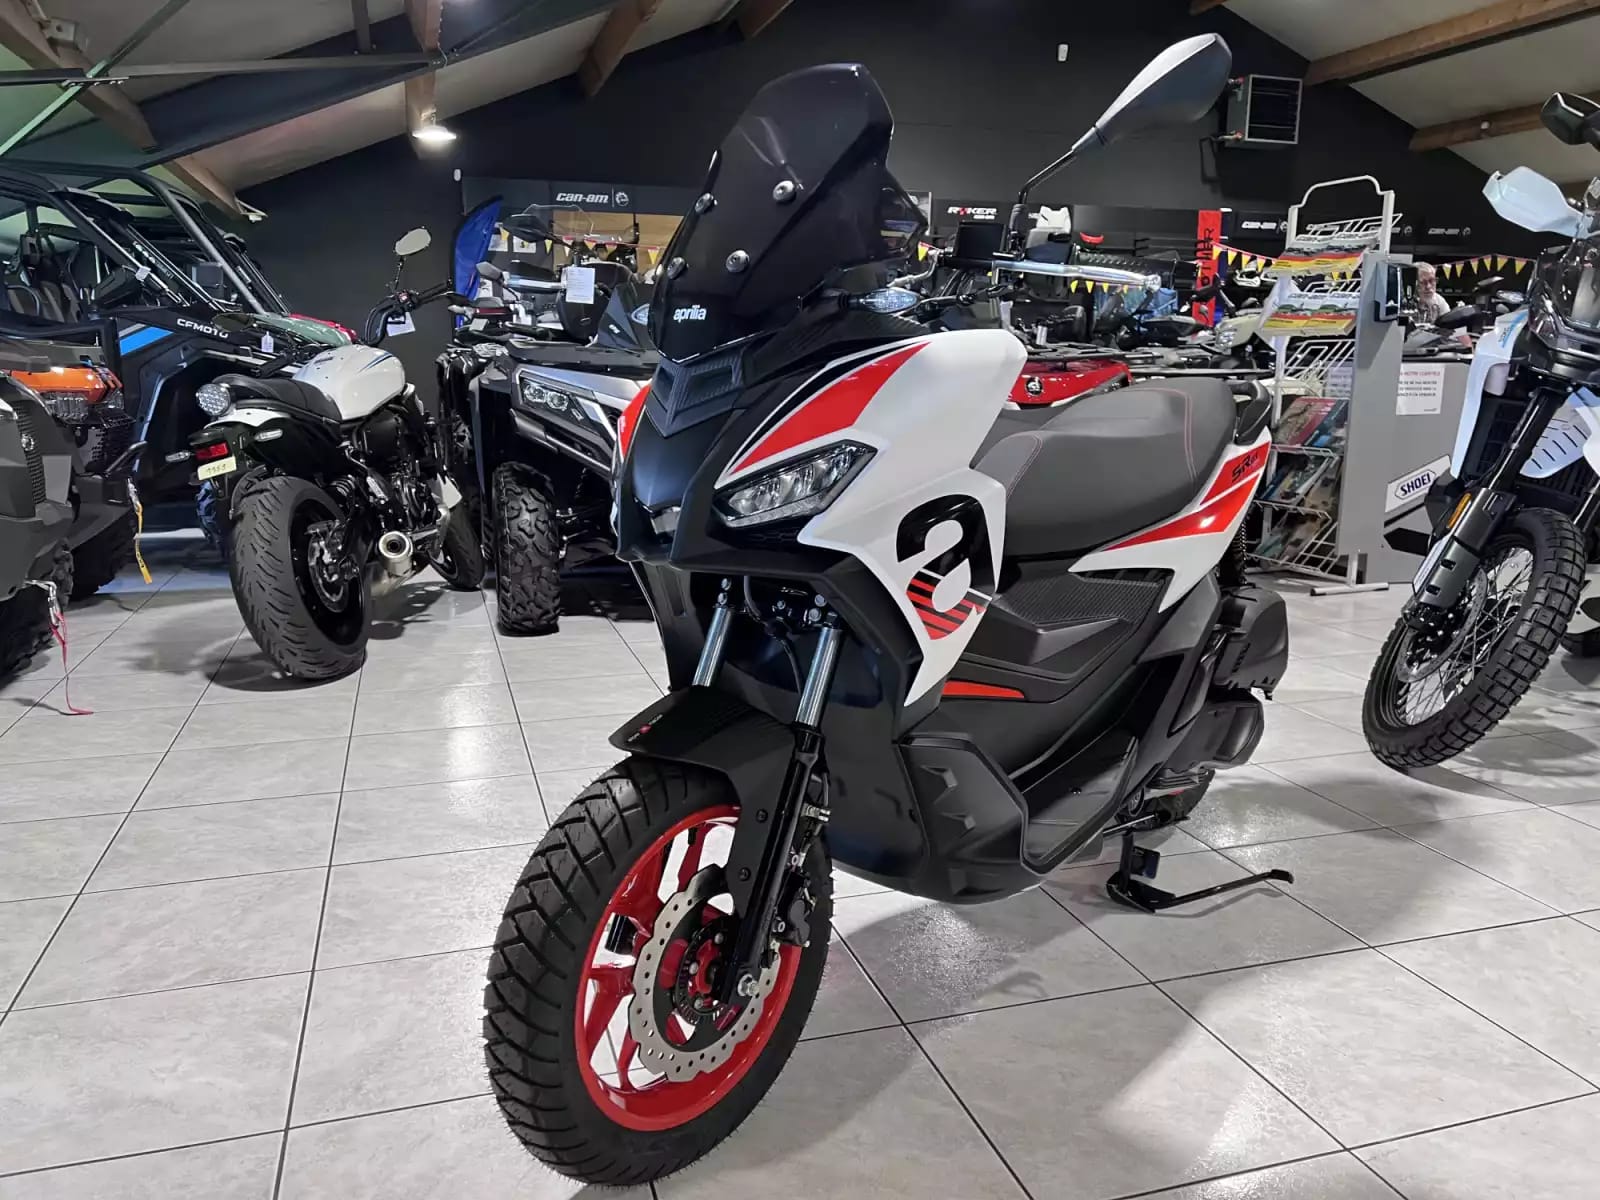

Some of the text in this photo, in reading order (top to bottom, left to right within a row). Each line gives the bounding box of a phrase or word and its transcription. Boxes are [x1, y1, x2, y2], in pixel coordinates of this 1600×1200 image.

[556, 192, 609, 204] can-am
[673, 304, 707, 323] aprilia
[1400, 472, 1431, 497] SHOEI
